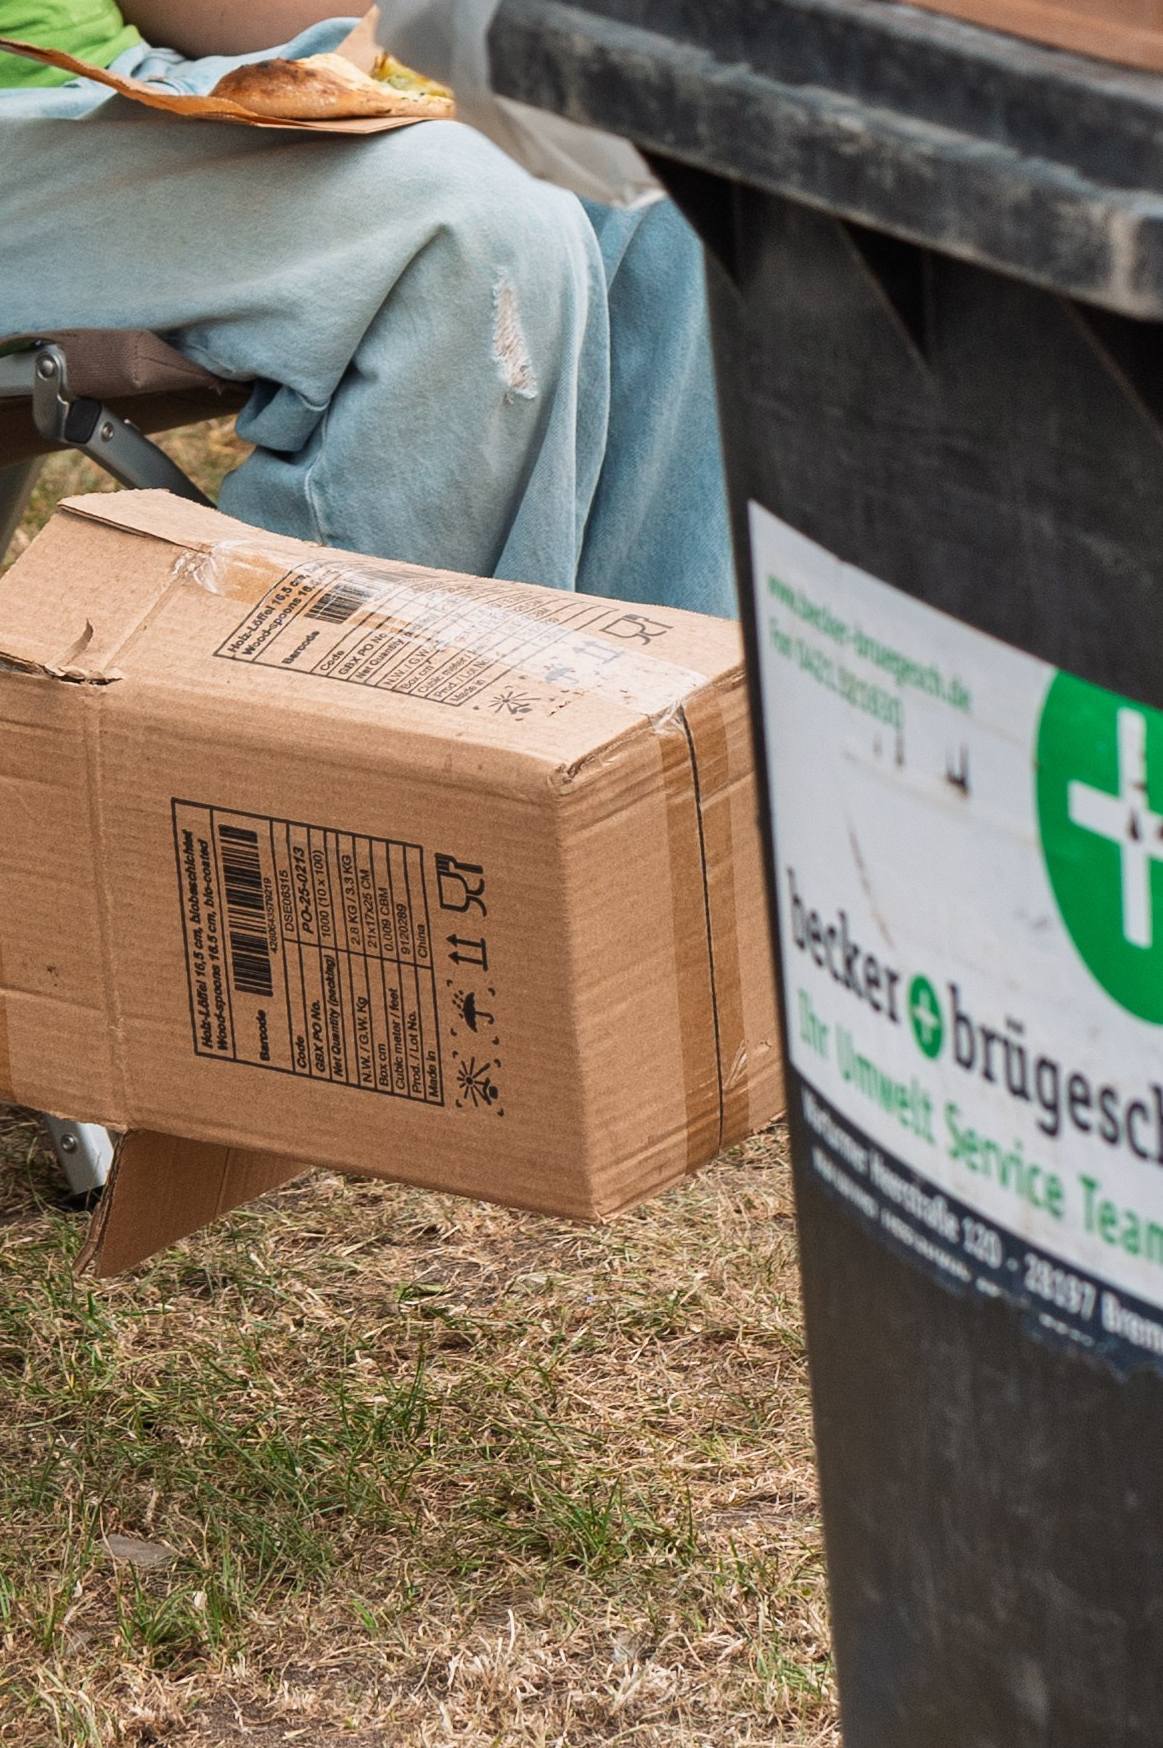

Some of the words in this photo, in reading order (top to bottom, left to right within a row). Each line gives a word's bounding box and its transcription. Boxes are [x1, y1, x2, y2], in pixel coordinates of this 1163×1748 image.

[227, 605, 276, 652] Holz-Löffel
[241, 597, 302, 656] Wood-spoons
[282, 631, 320, 664] Barcode
[320, 650, 345, 671] Code
[355, 667, 371, 679] Net
[369, 638, 405, 667] Quantity
[359, 643, 374, 656] PO
[401, 677, 418, 690] Box
[197, 837, 214, 908] bio-coated
[311, 848, 326, 876] 100)
[341, 853, 352, 875] KG
[292, 845, 314, 934] PO-25-0213
[344, 875, 355, 895] 3.3
[359, 868, 370, 890] CM
[278, 868, 294, 932] DSE06315
[316, 887, 329, 908] (10
[377, 885, 389, 916] CBM
[206, 909, 218, 934] cm,
[319, 909, 331, 938] 1000
[346, 903, 358, 924] KG
[362, 891, 377, 949] 21x17x25
[395, 902, 410, 955] 9120289
[192, 926, 204, 949] cm,
[206, 933, 219, 962] 16.5
[349, 925, 360, 945] 2.8
[381, 918, 393, 952] 0.009
[415, 923, 427, 959] China
[787, 865, 900, 1025] becker
[192, 951, 207, 977] 16,5
[323, 953, 339, 1007] (packing)
[208, 962, 229, 1051] Wood-spoons
[309, 998, 321, 1021] No.
[355, 995, 369, 1014] Kg
[387, 986, 398, 1010] feet
[311, 1021, 323, 1042] PO
[327, 1006, 342, 1056] Quantity
[356, 1014, 369, 1045] G.W.
[405, 1008, 417, 1031] No.
[255, 1008, 270, 1062] Barcode
[390, 1019, 402, 1054] meter
[407, 1032, 419, 1052] Lot
[294, 1034, 306, 1069] Code
[313, 1042, 325, 1073] GBX
[332, 1055, 343, 1077] Net
[377, 1042, 386, 1061] cm
[425, 1049, 435, 1062] in
[360, 1053, 372, 1083] N.W.
[377, 1062, 388, 1087] Box
[393, 1055, 405, 1090] Cubic
[409, 1061, 422, 1094] Prod.
[426, 1063, 438, 1097] Made
[836, 1021, 936, 1145] Umwelt
[944, 1100, 1065, 1220] Service
[962, 1216, 1003, 1269] 120
